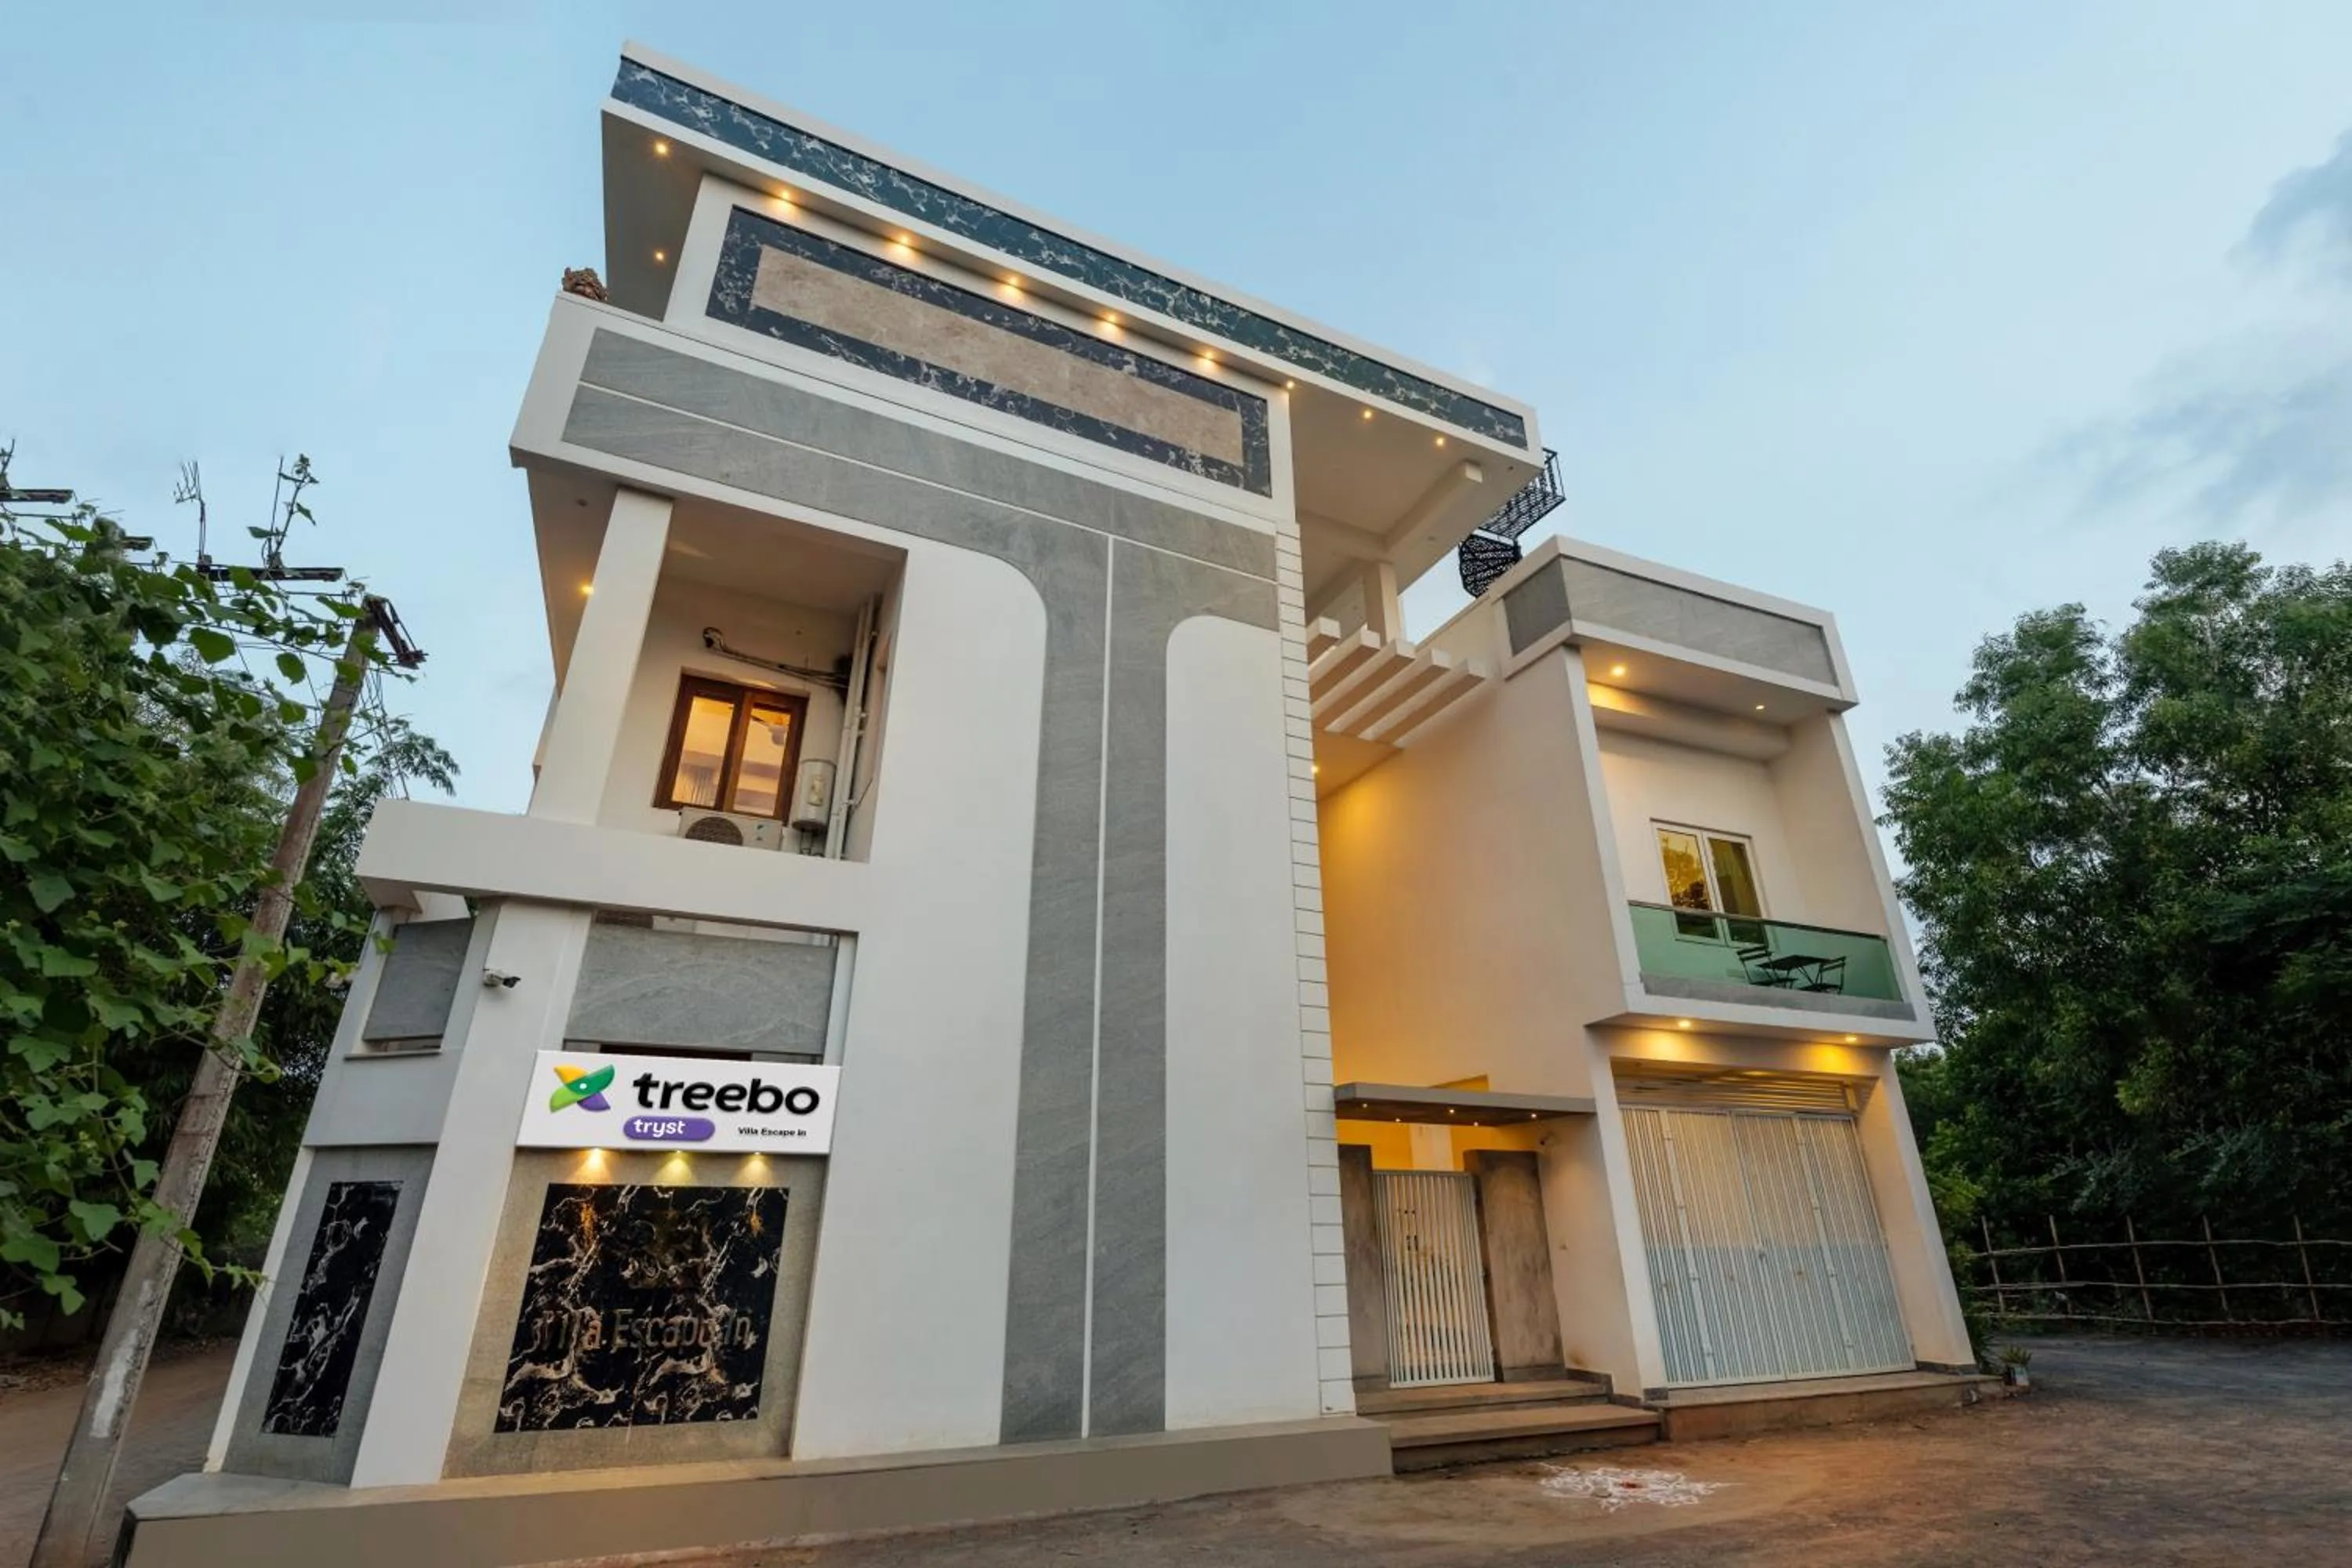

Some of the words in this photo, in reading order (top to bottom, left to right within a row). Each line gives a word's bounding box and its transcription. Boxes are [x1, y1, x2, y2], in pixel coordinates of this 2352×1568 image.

[633, 1073, 820, 1115] treebo
[633, 1120, 686, 1138] tryst
[760, 1127, 796, 1137] Escape
[541, 1310, 602, 1349] Via
